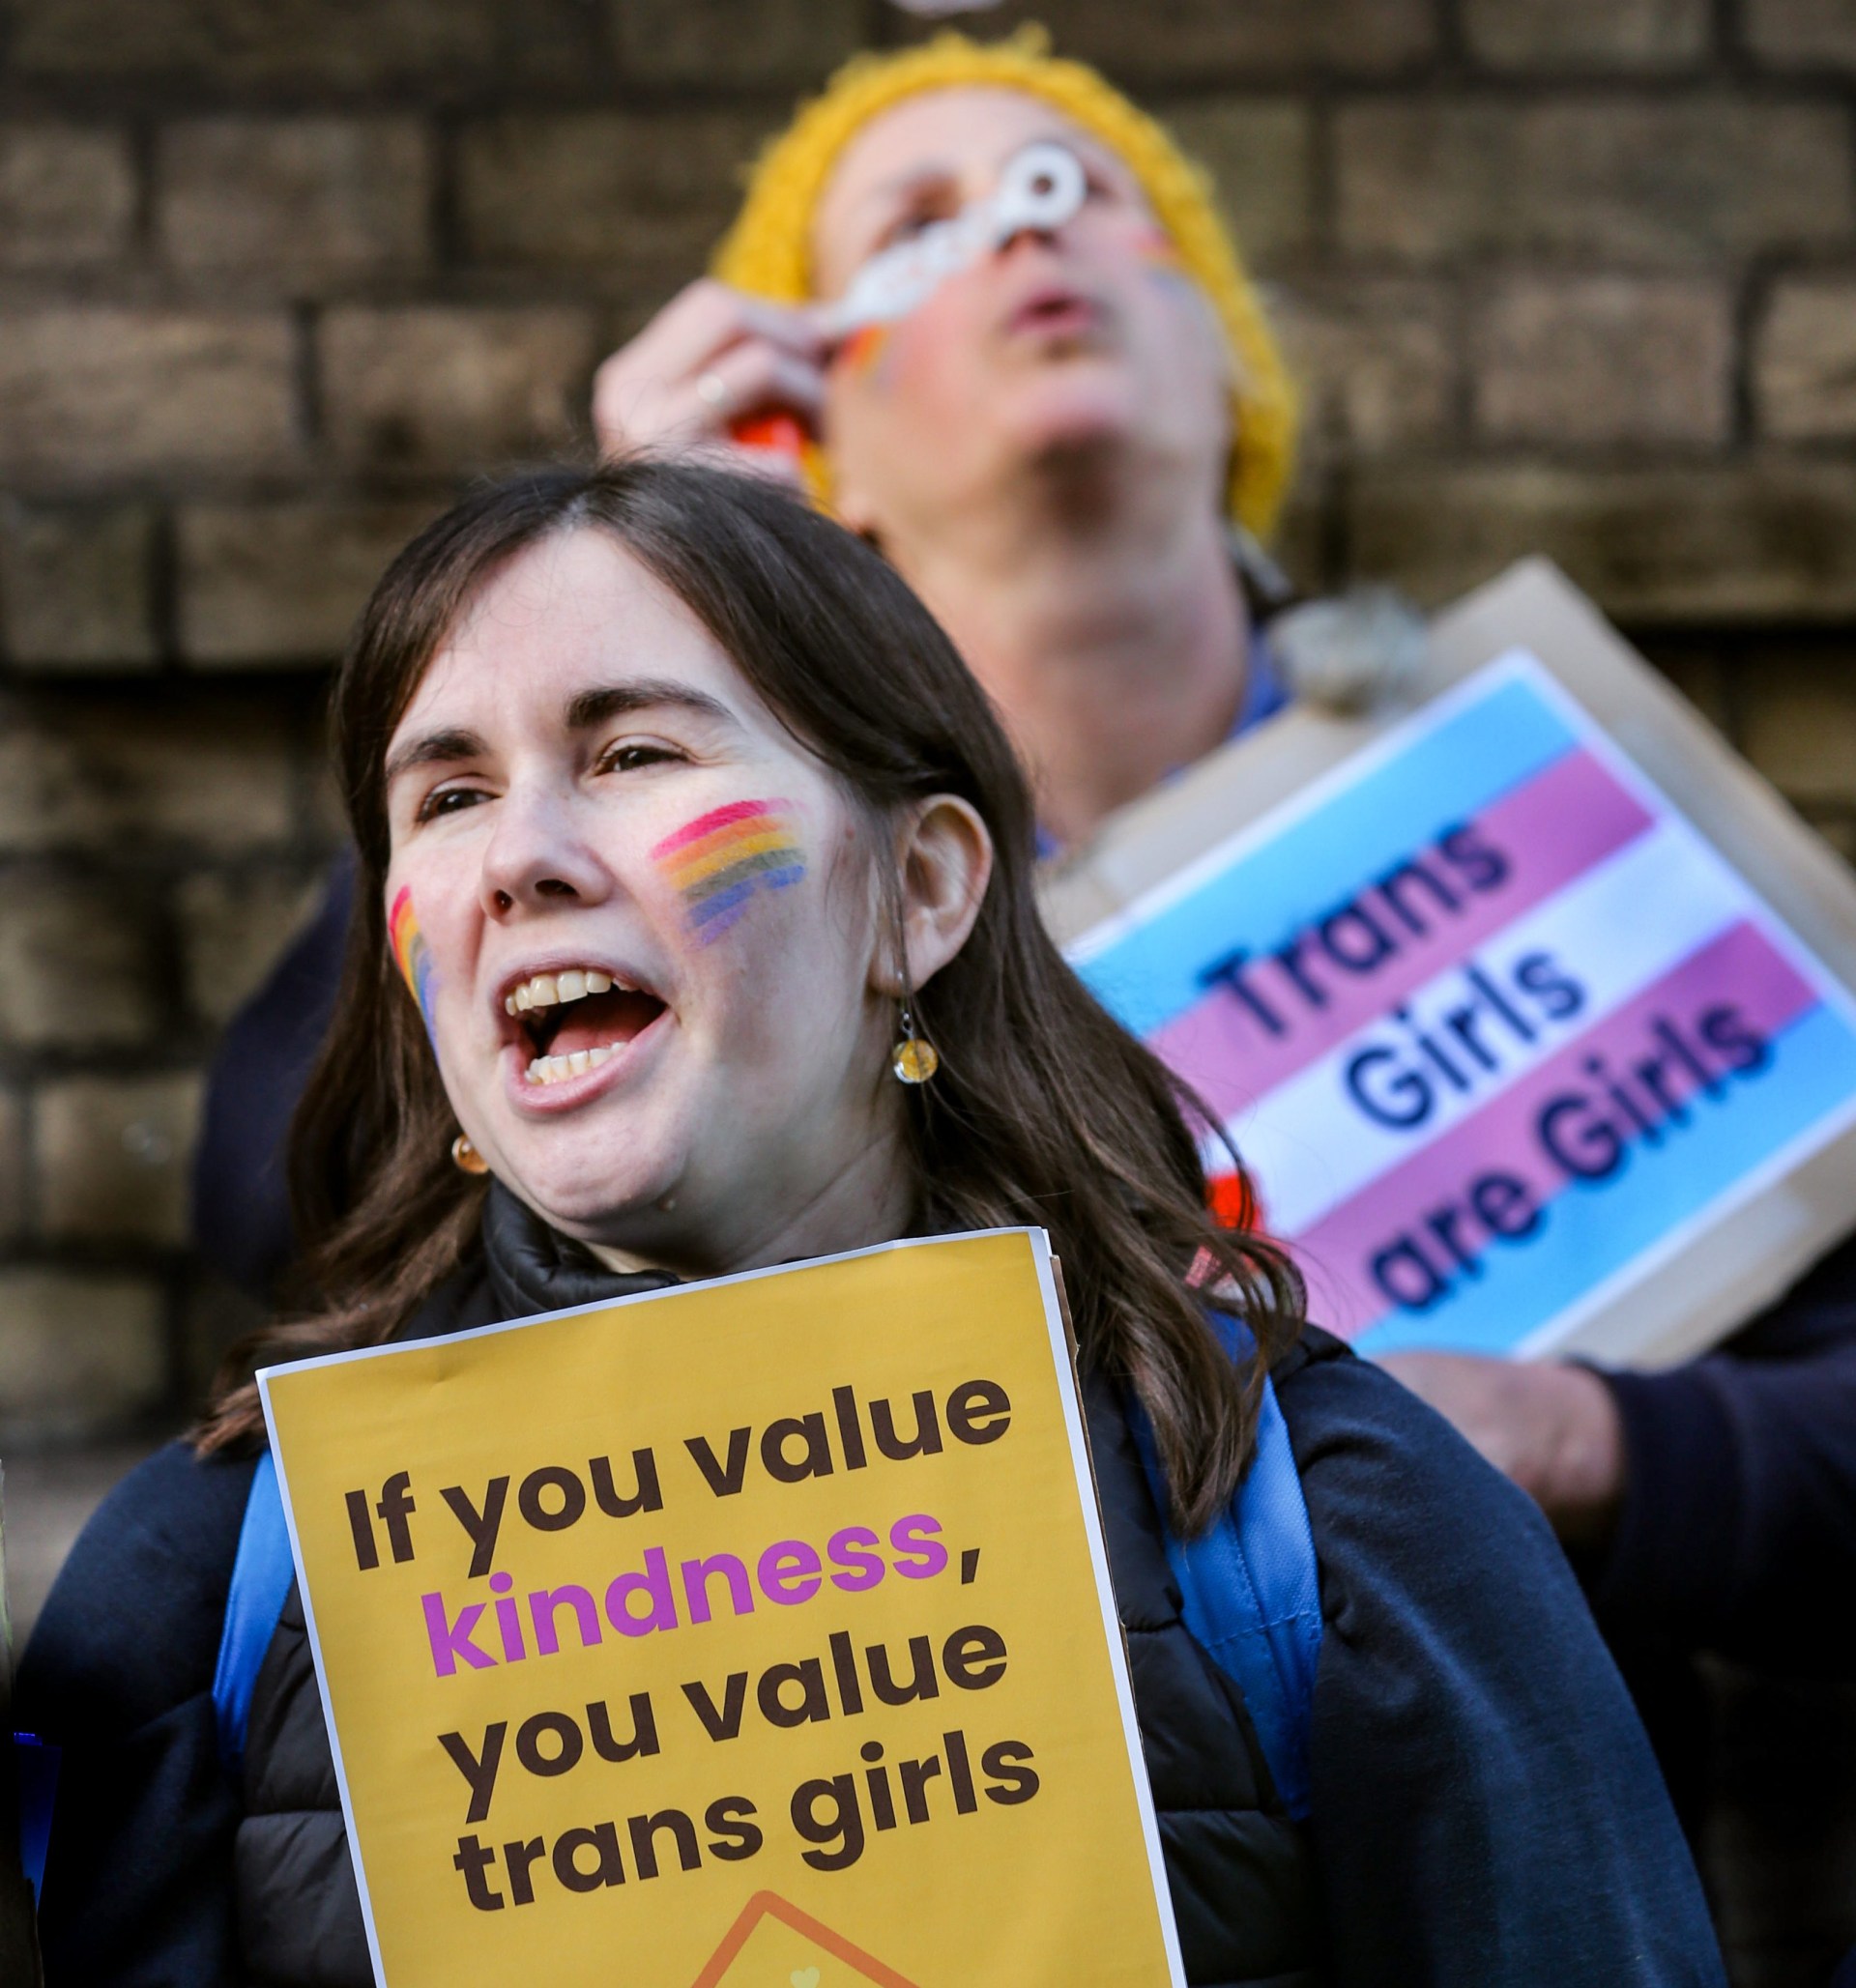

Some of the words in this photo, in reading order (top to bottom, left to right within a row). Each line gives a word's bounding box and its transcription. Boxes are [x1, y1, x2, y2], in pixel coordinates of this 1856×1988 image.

[1198, 821, 1512, 1038] Trans
[1344, 949, 1586, 1130] Girls
[1365, 1170, 1545, 1312] are
[1533, 999, 1771, 1185] Girls
[344, 1471, 417, 1572] If
[439, 1447, 664, 1578] you
[682, 1379, 1012, 1497] value
[420, 1513, 980, 1677] kindness,
[437, 1692, 661, 1825] you
[680, 1625, 1008, 1743] value
[452, 1796, 764, 1912] trans
[790, 1730, 1040, 1872] girls
